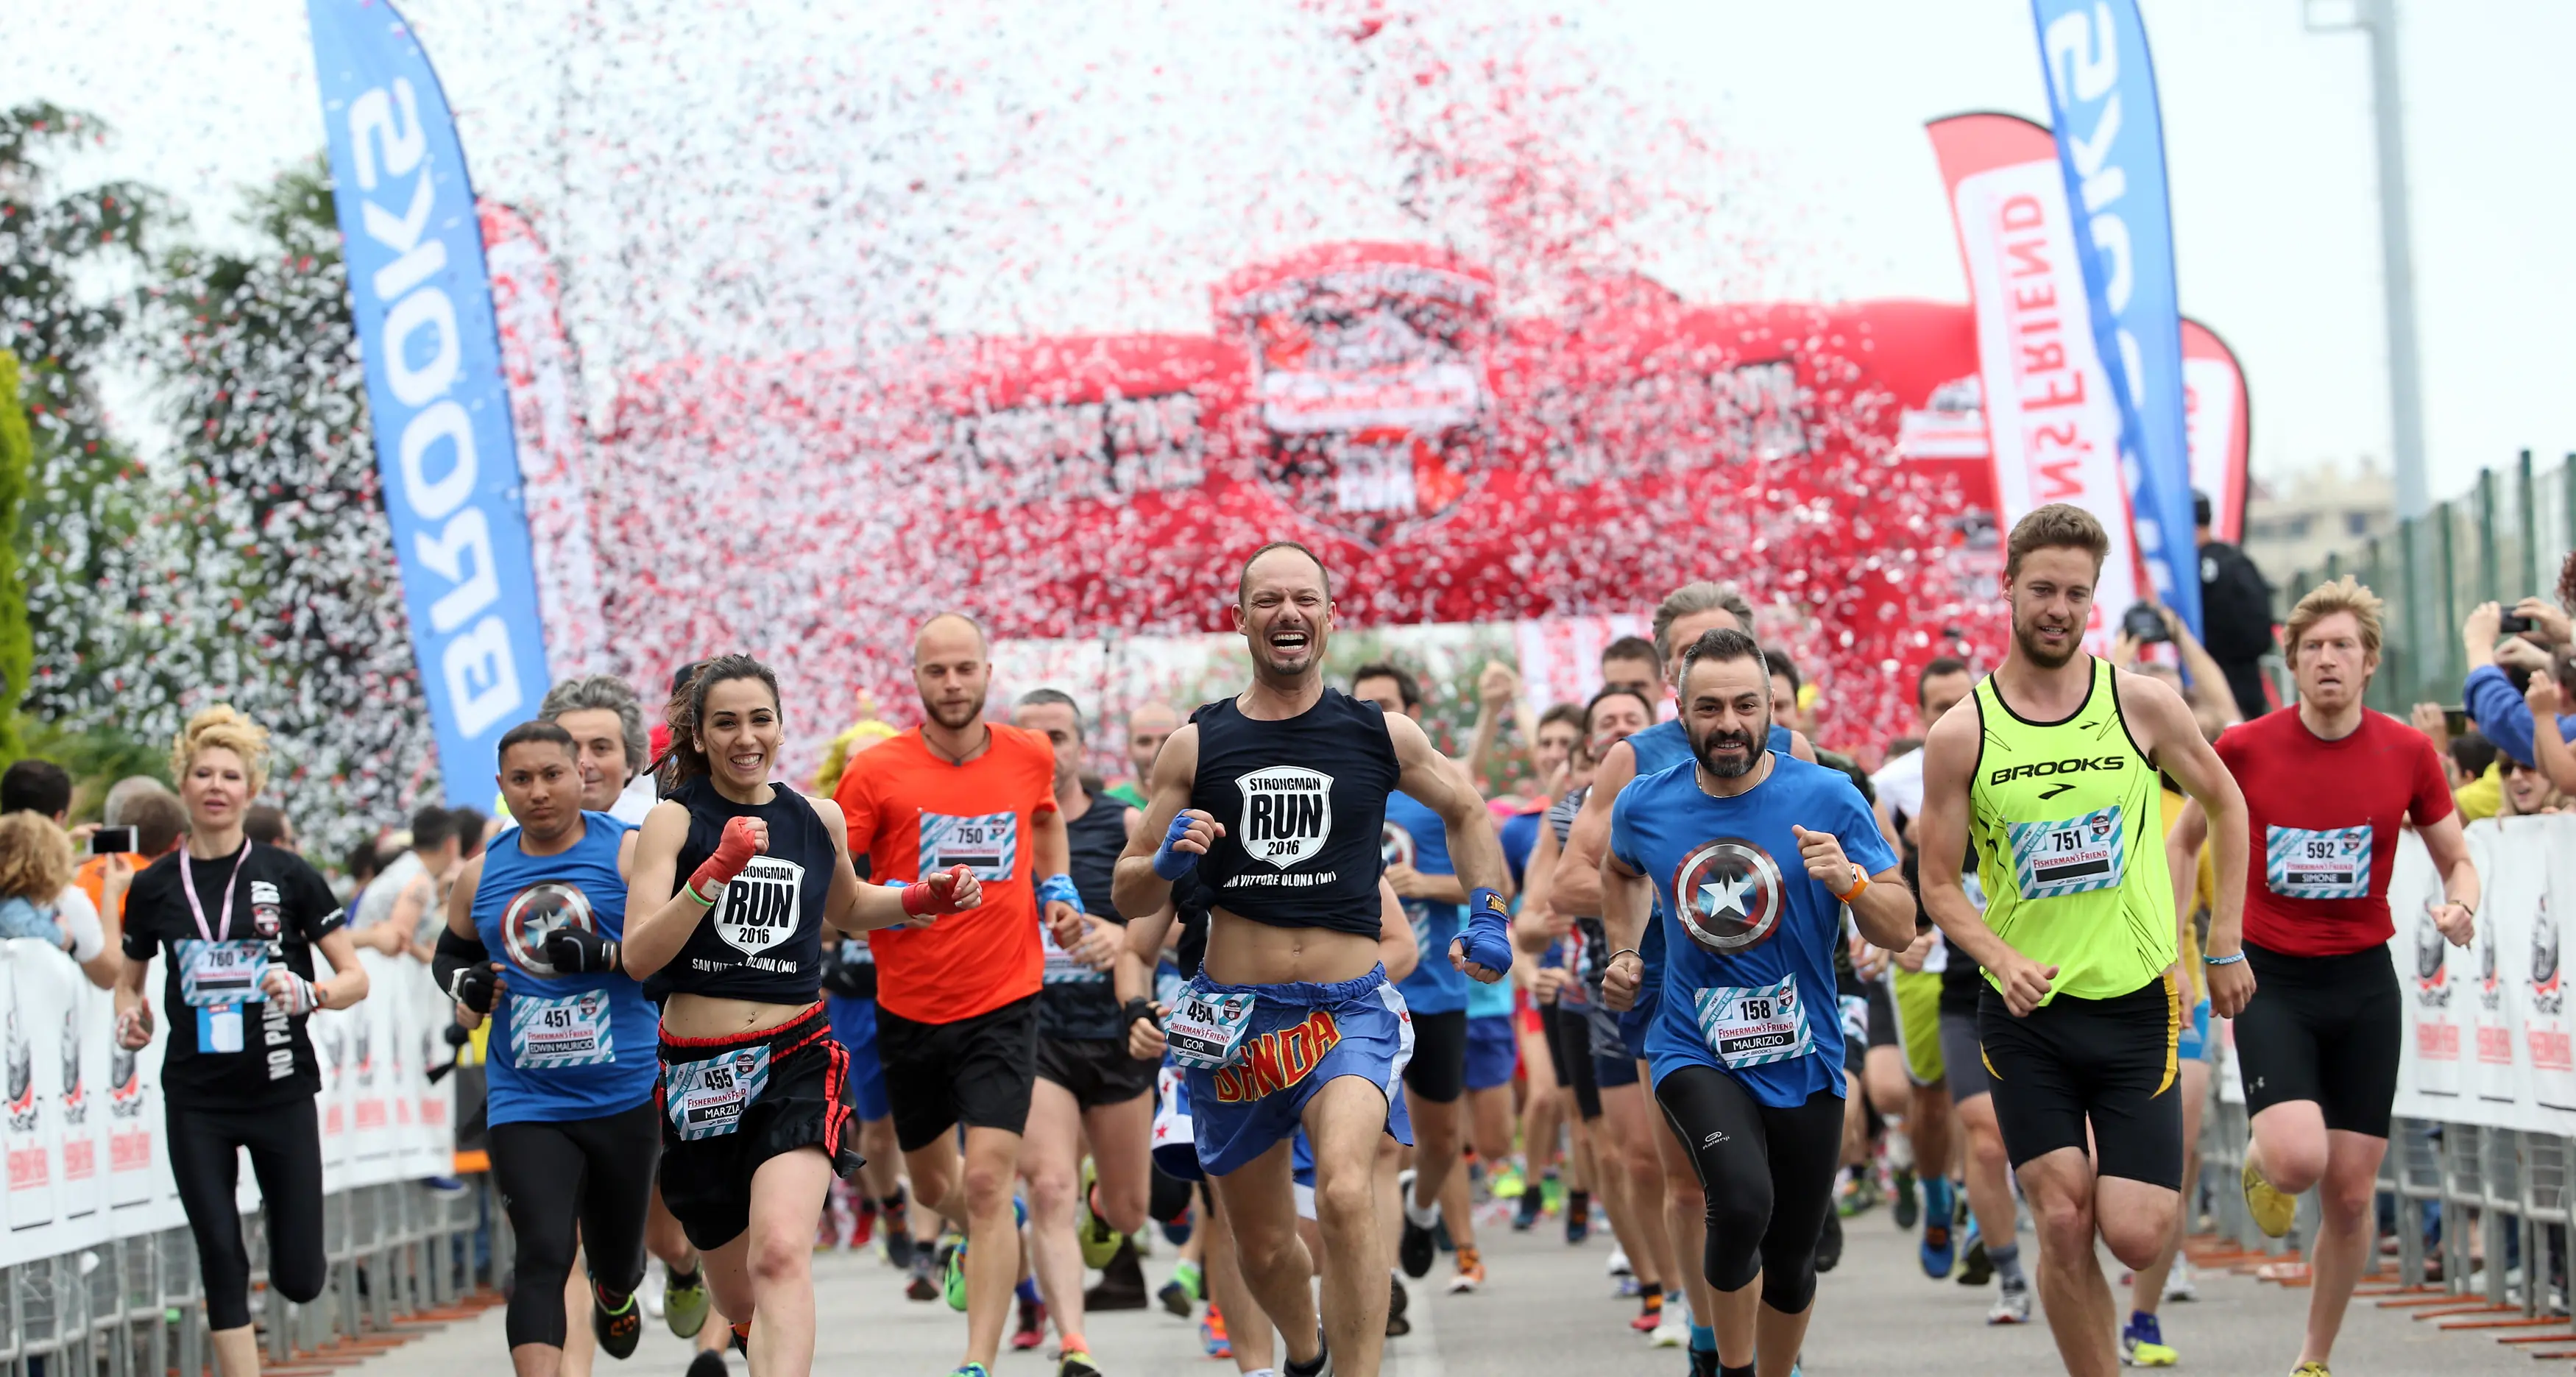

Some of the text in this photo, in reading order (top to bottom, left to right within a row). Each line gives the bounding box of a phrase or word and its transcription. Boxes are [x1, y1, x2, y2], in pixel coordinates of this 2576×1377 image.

[1990, 756, 2125, 786] BROOKS
[1249, 777, 1321, 791] STRONGMAN
[1249, 793, 1323, 841] RUN
[958, 828, 983, 843] 750
[2052, 829, 2082, 852] 751
[1267, 840, 1301, 856] 2016
[2307, 842, 2335, 859] 592
[2033, 850, 2108, 868] FISHERMAN'S FRIEND
[739, 866, 793, 881] RONGMAN
[1239, 874, 1280, 888] VITTORE
[1281, 874, 1314, 887] OLONA
[1315, 871, 1337, 885] (MI)
[2301, 874, 2338, 882] SIMONE
[722, 879, 794, 928] RUN
[738, 927, 770, 944] 2016
[208, 951, 234, 967] 760
[693, 958, 711, 972] SAN
[545, 1009, 571, 1028] 451
[1186, 1000, 1215, 1026] 454
[1740, 999, 1772, 1021] 158
[1204, 1029, 1231, 1043] FRIEND
[1718, 1022, 1794, 1039] FISHERMAN'S FRIEND
[530, 1039, 594, 1053] EDWIN MAURICIO
[1183, 1038, 1205, 1052] IGOR
[1733, 1035, 1784, 1051] MAURIZIO
[267, 1048, 294, 1081] NO
[704, 1067, 734, 1091] 455
[687, 1092, 732, 1108] FISHERMAN'S
[705, 1104, 740, 1119] MARZIA
